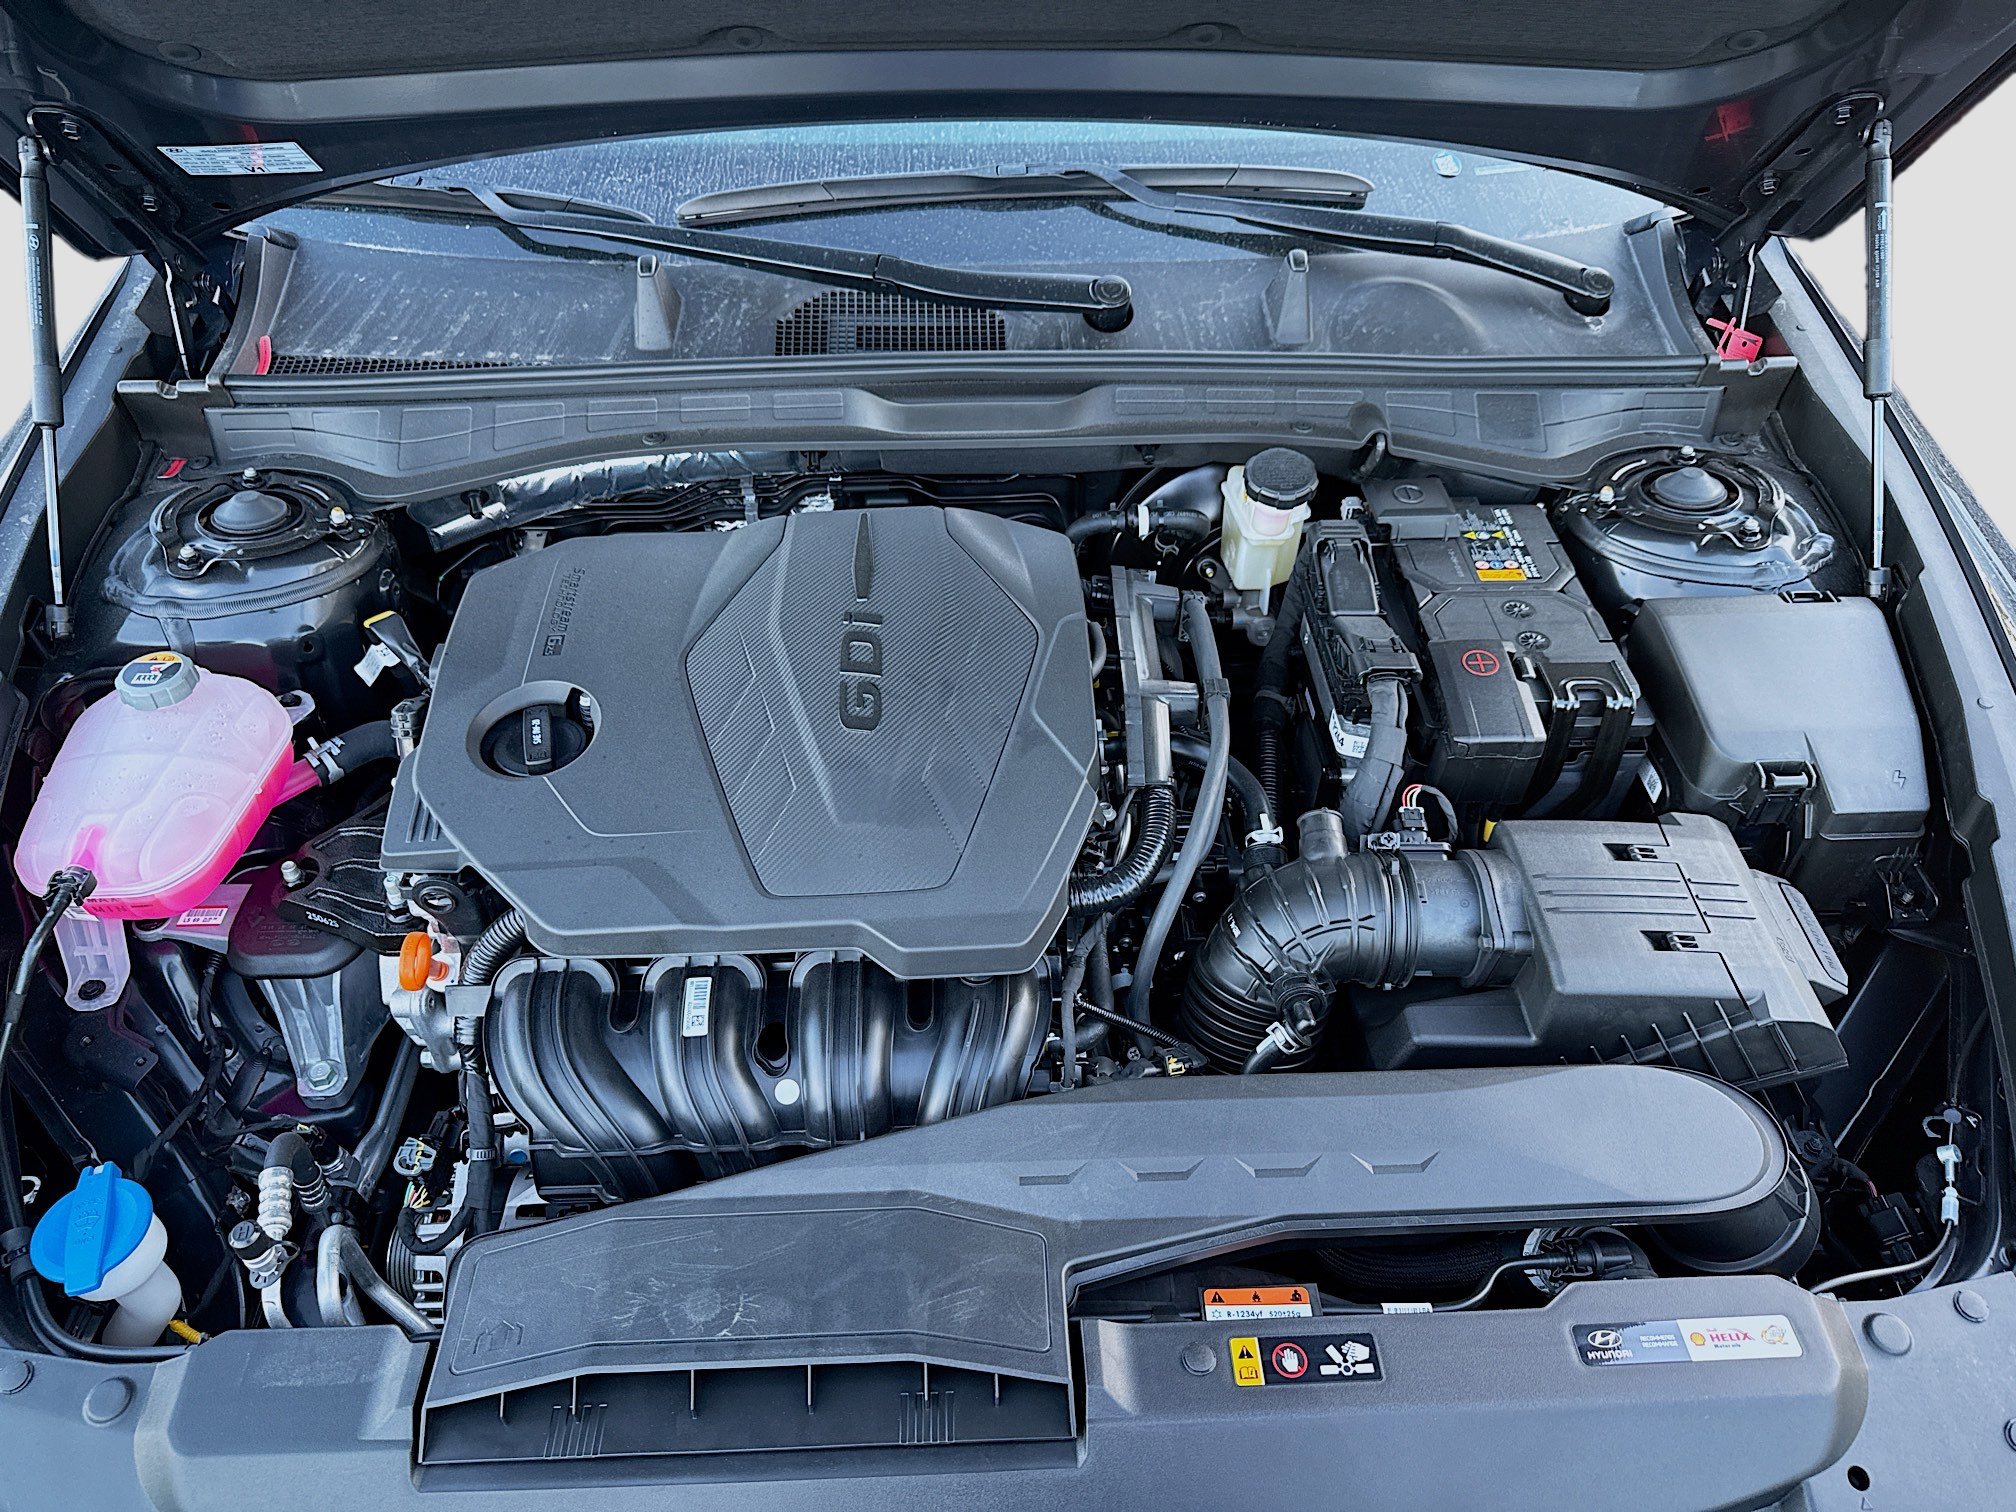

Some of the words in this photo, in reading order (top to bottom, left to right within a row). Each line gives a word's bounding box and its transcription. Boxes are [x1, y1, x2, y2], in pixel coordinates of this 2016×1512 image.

[550, 574, 571, 632] TECHNOLOGY
[558, 567, 586, 632] Smartstream
[840, 611, 882, 732] GDi
[1587, 1349, 1634, 1360] HYUNDAI
[1709, 1332, 1752, 1342] HELIX
